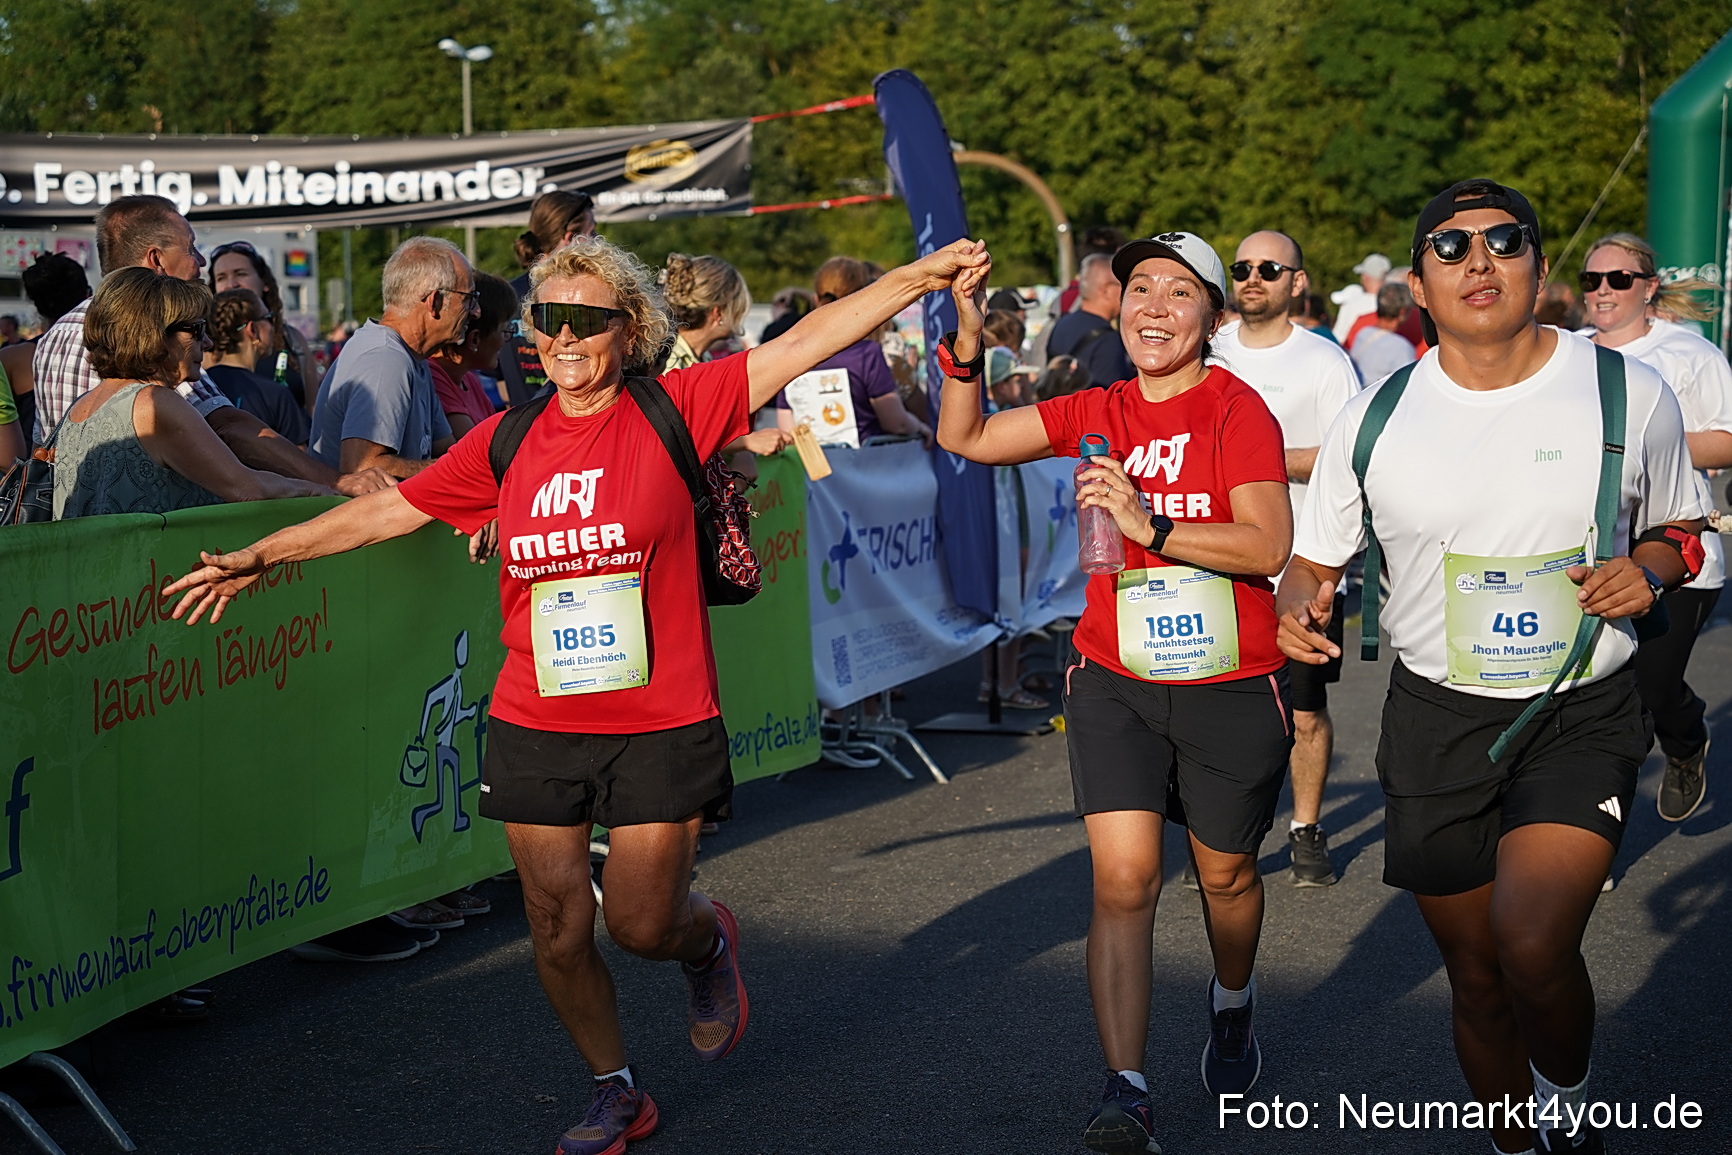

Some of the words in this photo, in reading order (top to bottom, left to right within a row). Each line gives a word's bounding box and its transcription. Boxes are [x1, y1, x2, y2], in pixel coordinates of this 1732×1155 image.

[33, 160, 208, 217] Fertig.
[218, 160, 558, 206] Miteinander.
[1123, 432, 1191, 485] MRT
[1534, 448, 1562, 463] Jhon
[530, 467, 604, 520] MRT
[1135, 492, 1212, 518] EIER
[509, 523, 627, 561] MEIER
[507, 557, 584, 579] Running
[585, 551, 642, 570] Team
[1144, 588, 1179, 599] Firmenlauf
[1478, 582, 1523, 591] Firmenlauf
[554, 599, 587, 611] Firmenlauf
[552, 623, 616, 651] 1885
[1145, 613, 1204, 639] 1881
[1492, 612, 1539, 637] 46
[1143, 636, 1214, 649] Munkhtsetseg
[1154, 649, 1206, 661] Batmunkh
[1471, 644, 1500, 655] Jhon
[1504, 641, 1567, 656] Maucaylle
[94, 643, 204, 735] laufen
[216, 587, 333, 690] länger!
[552, 657, 575, 668] Heidi
[577, 652, 627, 665] Ebenhöch
